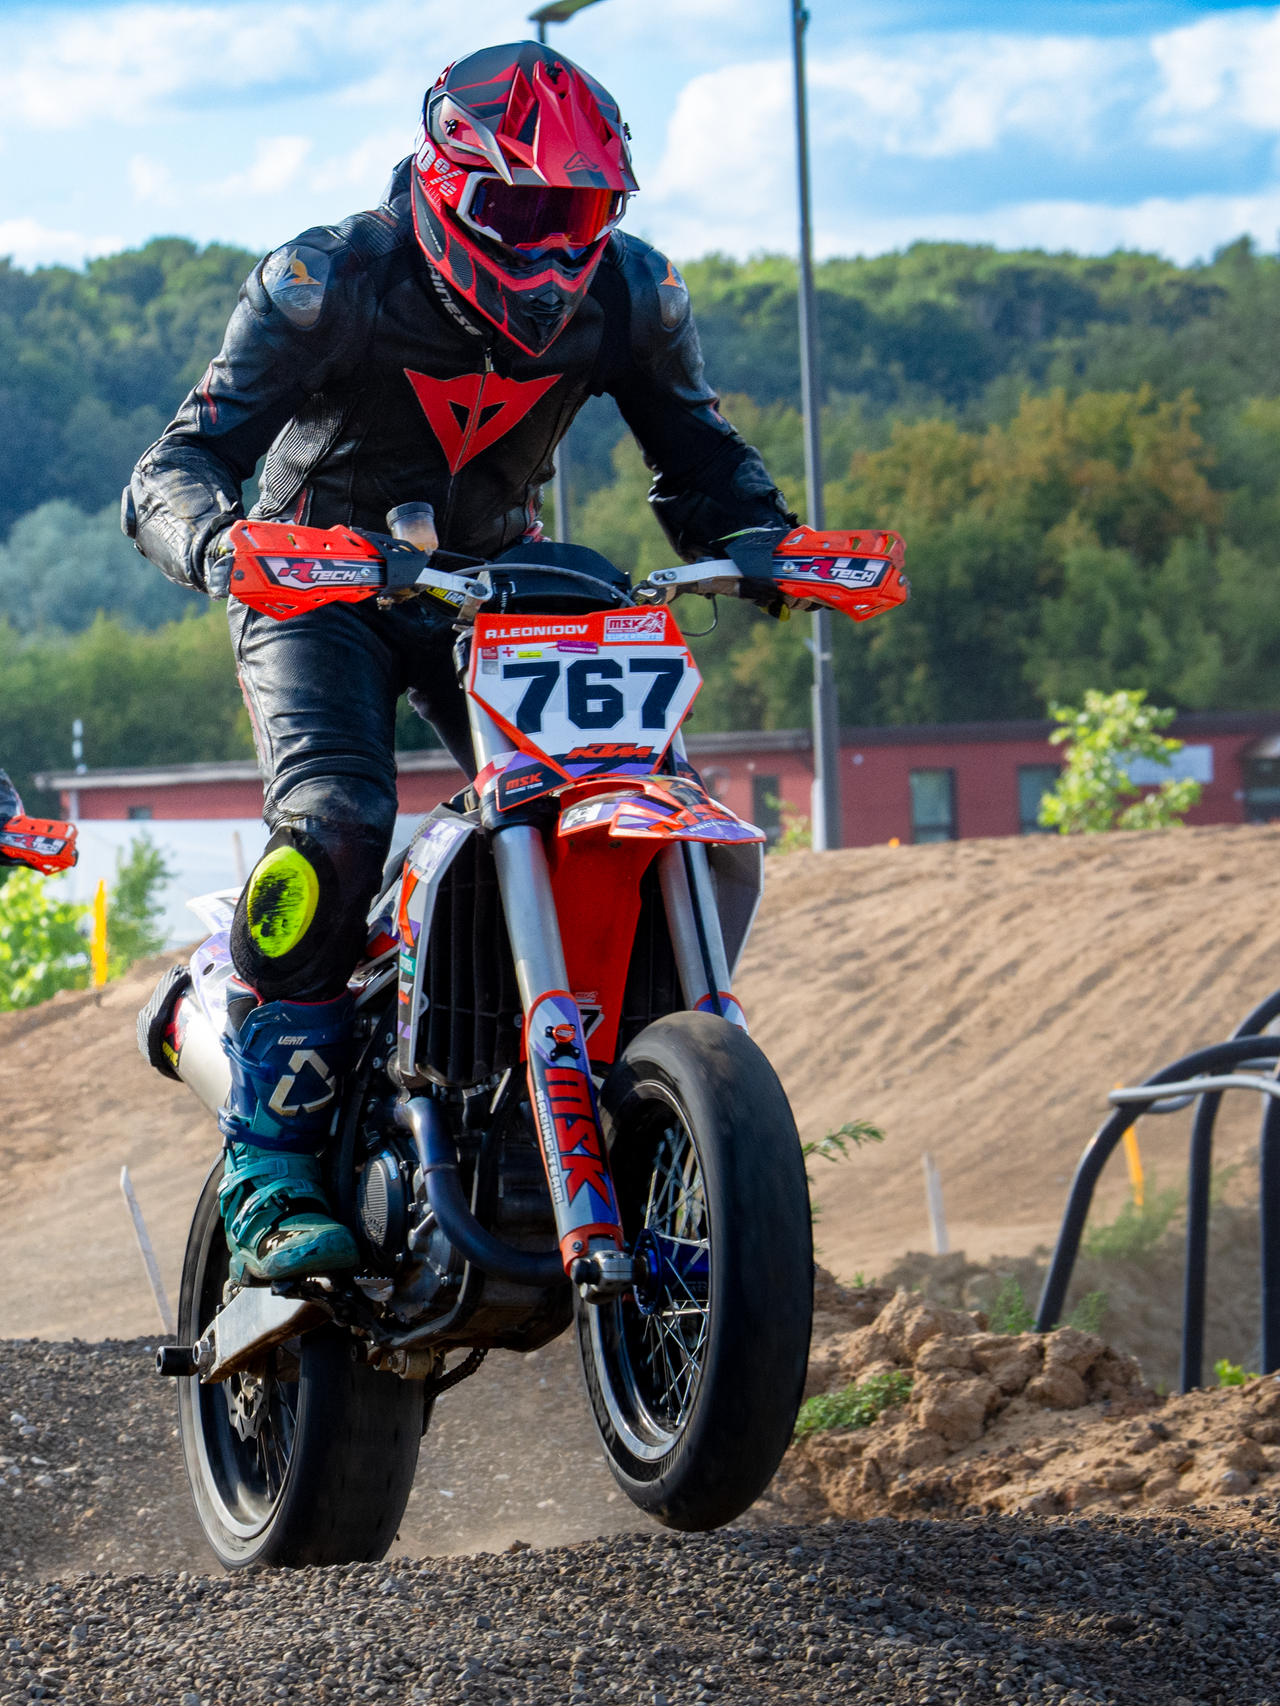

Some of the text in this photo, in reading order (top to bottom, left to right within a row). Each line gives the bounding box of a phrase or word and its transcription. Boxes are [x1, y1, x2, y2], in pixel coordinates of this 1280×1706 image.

[485, 624, 589, 639] A.LEONIDOV
[502, 657, 685, 734] 767
[565, 743, 655, 759] KTM
[505, 772, 543, 791] MSK
[277, 1035, 308, 1046] LEATT
[535, 1089, 564, 1205] RACING TEAM
[544, 1065, 613, 1212] MSK
